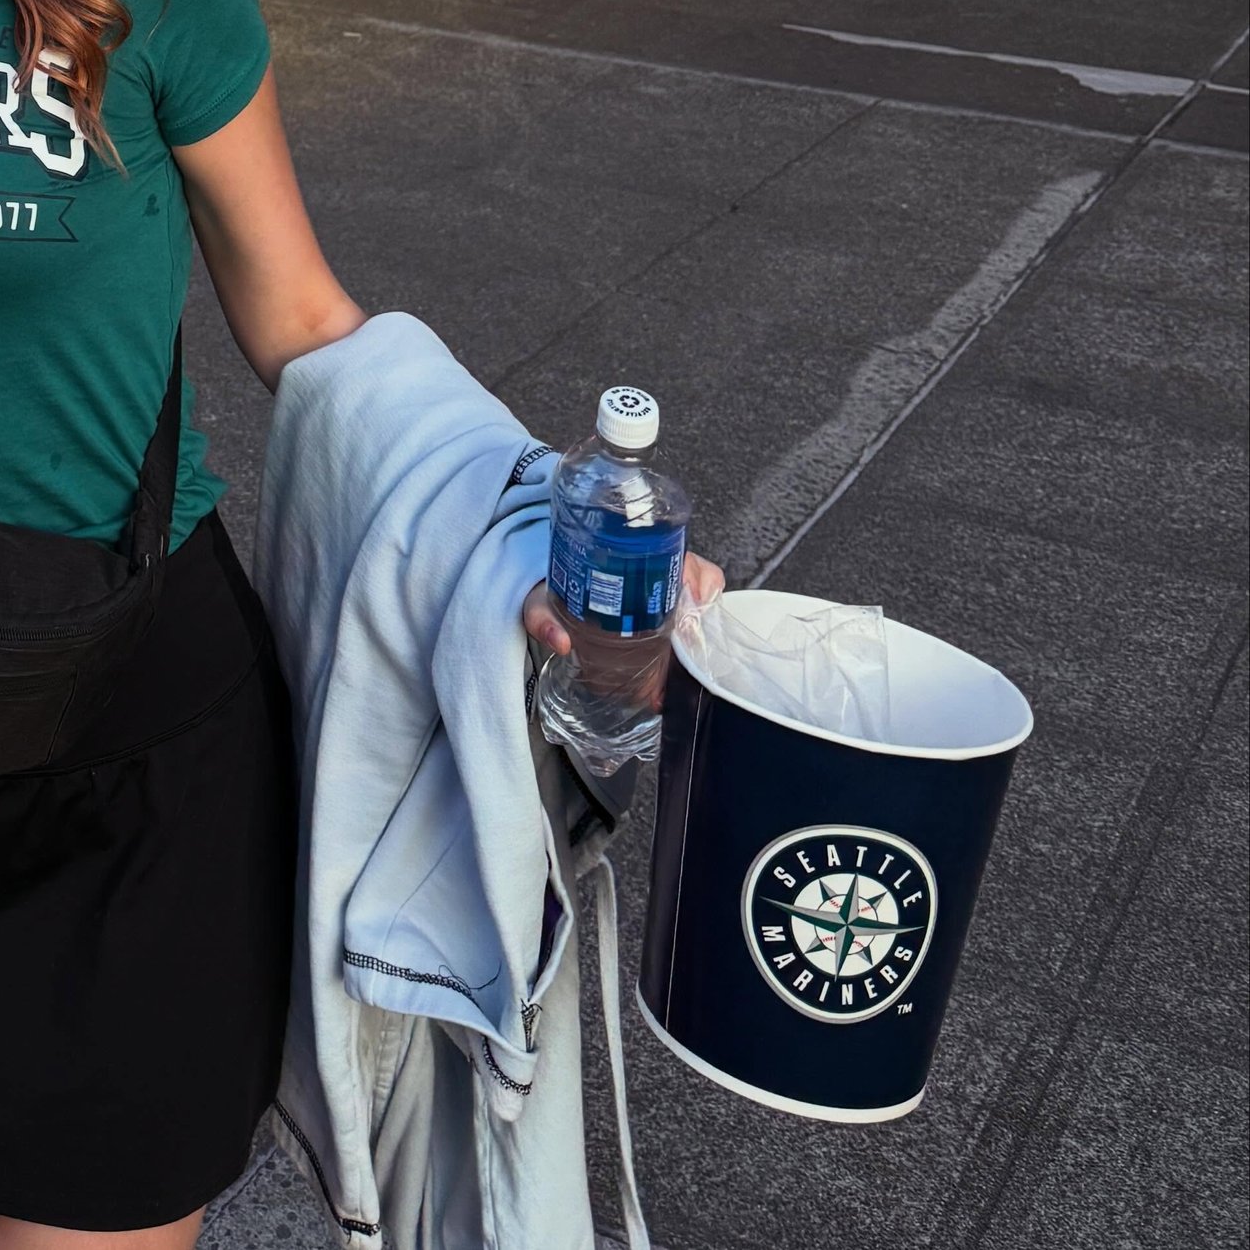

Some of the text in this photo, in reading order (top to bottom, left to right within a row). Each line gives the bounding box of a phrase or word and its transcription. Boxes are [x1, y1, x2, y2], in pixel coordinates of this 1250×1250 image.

[772, 843, 923, 909] SEATTLE
[760, 925, 914, 1006] MARINERS
[896, 1002, 914, 1015] TM
